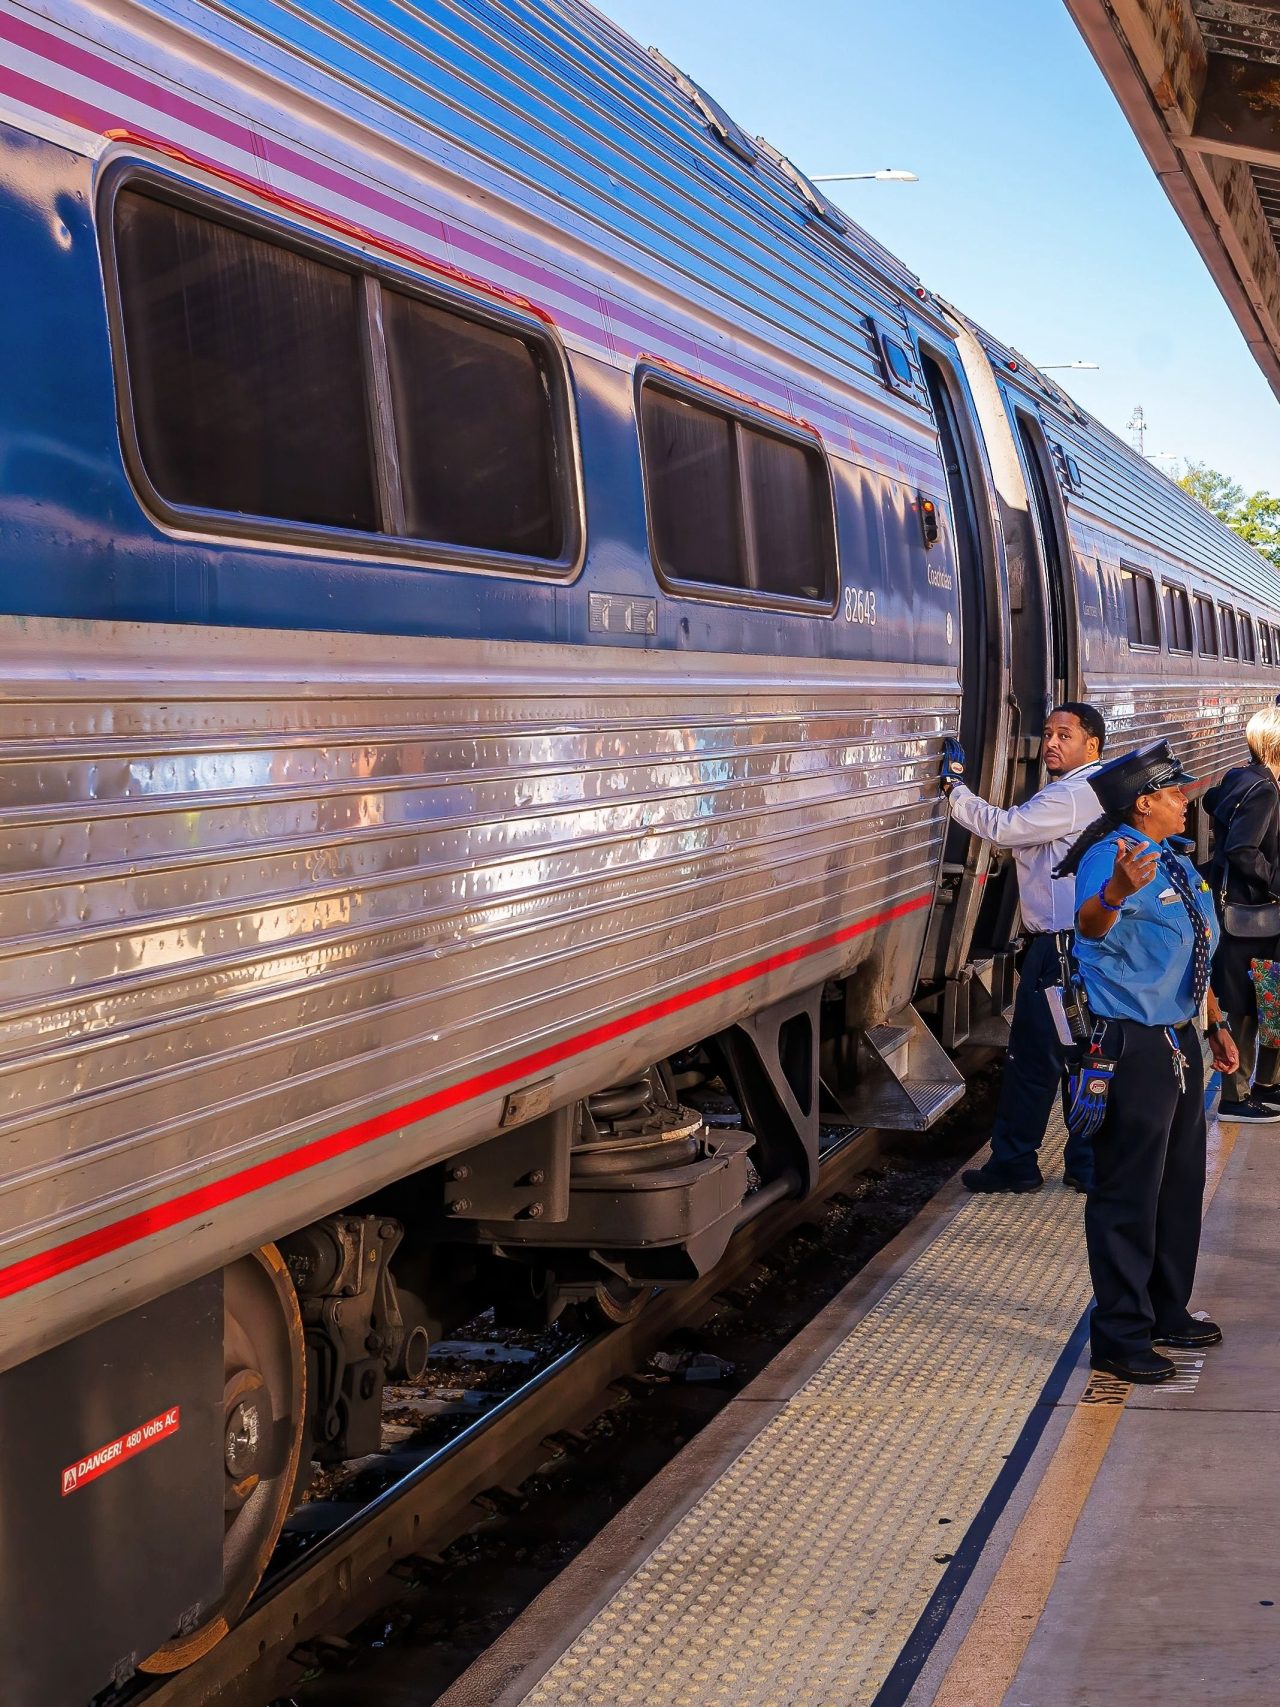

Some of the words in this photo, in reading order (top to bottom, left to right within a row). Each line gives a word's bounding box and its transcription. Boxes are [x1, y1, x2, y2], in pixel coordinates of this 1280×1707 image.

[844, 586, 877, 626] 82643
[78, 1441, 122, 1478] DANGER!
[126, 1430, 141, 1448] 480
[143, 1420, 163, 1440] Volts
[165, 1410, 177, 1428] AC
